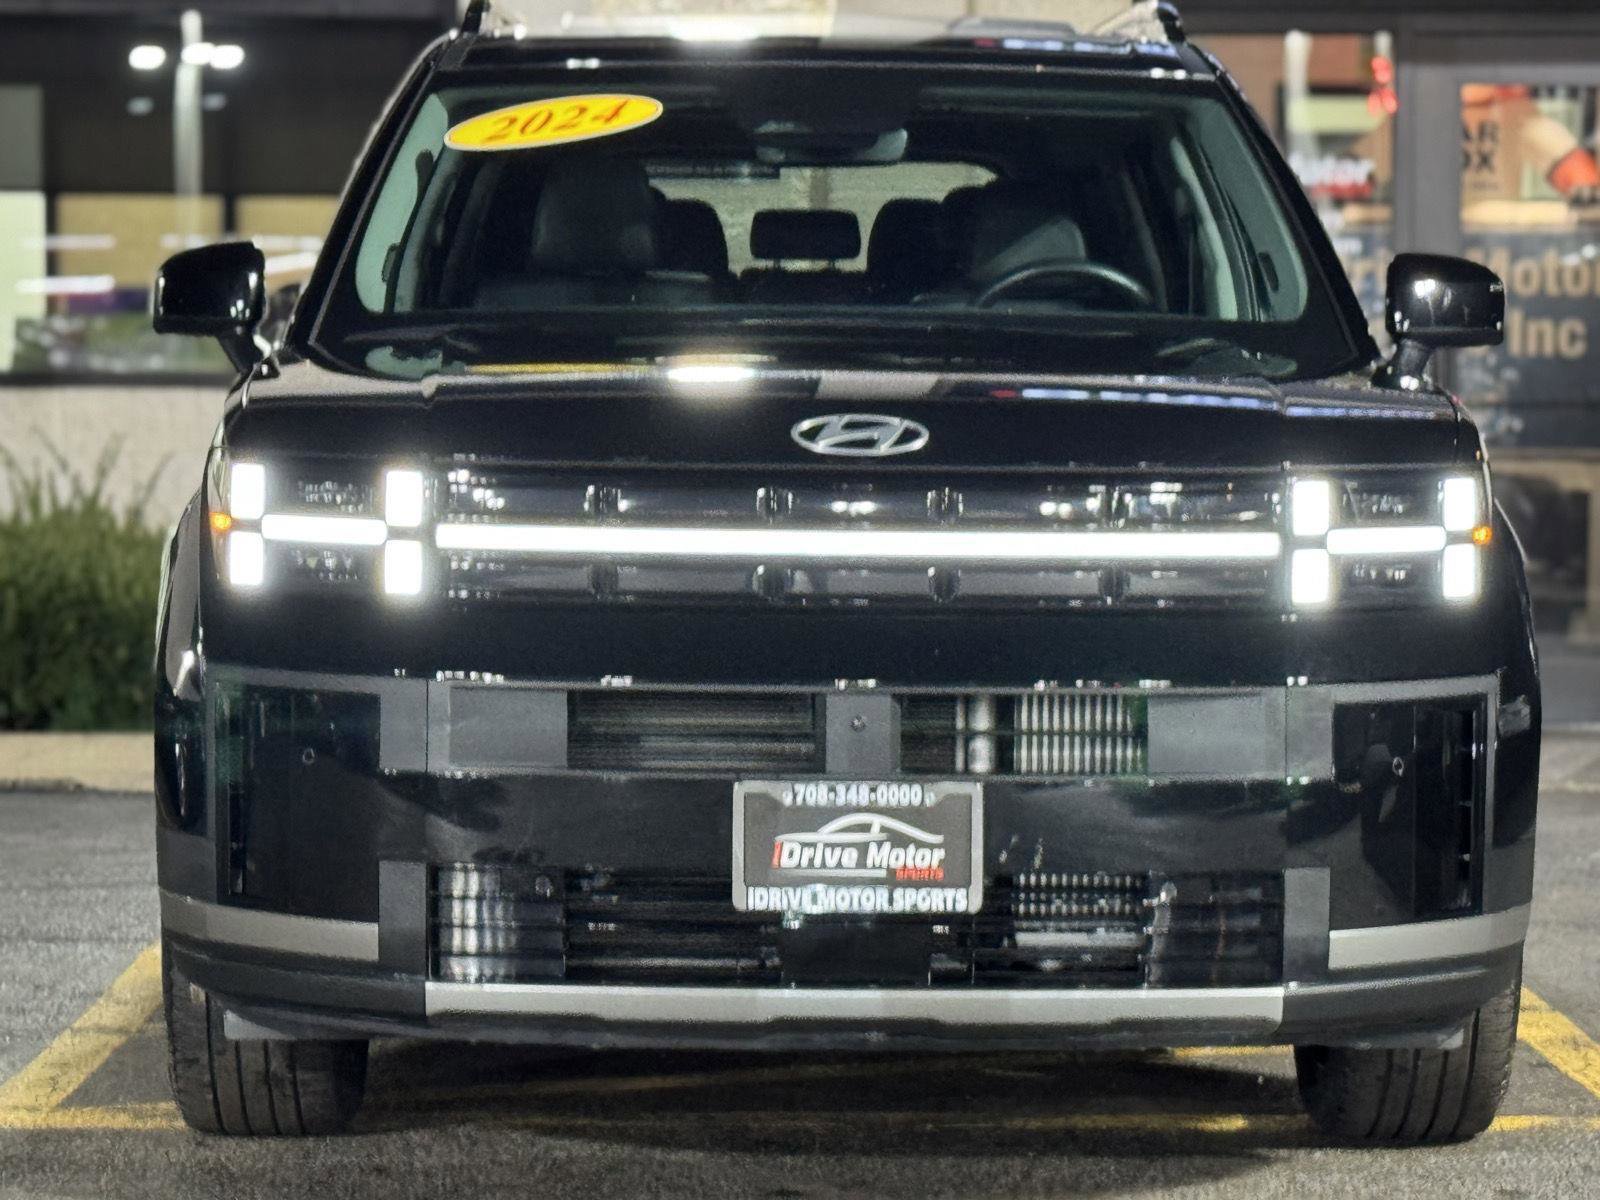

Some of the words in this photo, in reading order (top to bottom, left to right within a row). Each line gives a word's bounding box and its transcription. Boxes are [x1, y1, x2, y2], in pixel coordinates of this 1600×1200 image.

[481, 100, 629, 143] 2024
[1465, 248, 1600, 297] Moto
[1508, 308, 1588, 359] Inc
[866, 841, 946, 869] Motor
